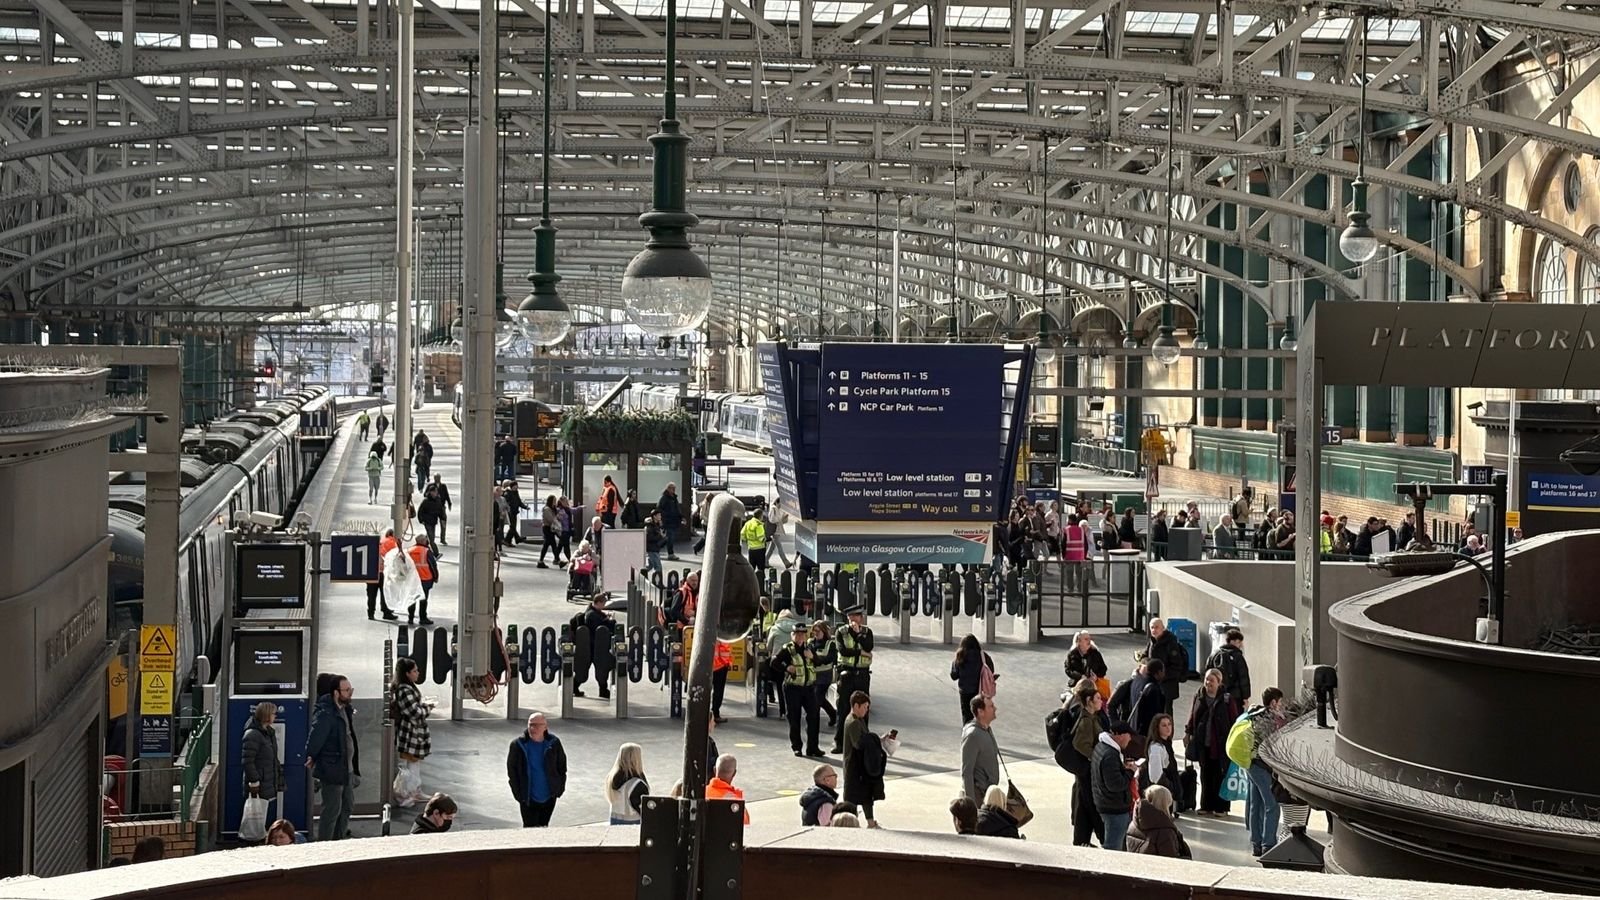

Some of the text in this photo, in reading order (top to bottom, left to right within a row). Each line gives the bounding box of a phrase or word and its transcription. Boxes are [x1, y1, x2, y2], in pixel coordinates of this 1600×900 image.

[1371, 327, 1600, 349] PLATFORM
[861, 371, 901, 380] Platforms
[903, 372, 910, 380] 11
[919, 372, 928, 380] 15
[853, 387, 951, 397] Cycle Park Platform 15
[703, 400, 713, 409] 13
[860, 402, 914, 411] NCP Car Park
[306, 411, 321, 427] 11
[1326, 430, 1341, 443] 15
[886, 473, 955, 482] Low level station
[843, 488, 861, 497] Low
[863, 488, 883, 497] level
[884, 488, 913, 497] station
[921, 504, 958, 514] Way out
[826, 544, 964, 555] Welcome to Glasgow Central Station
[340, 544, 368, 576] 11
